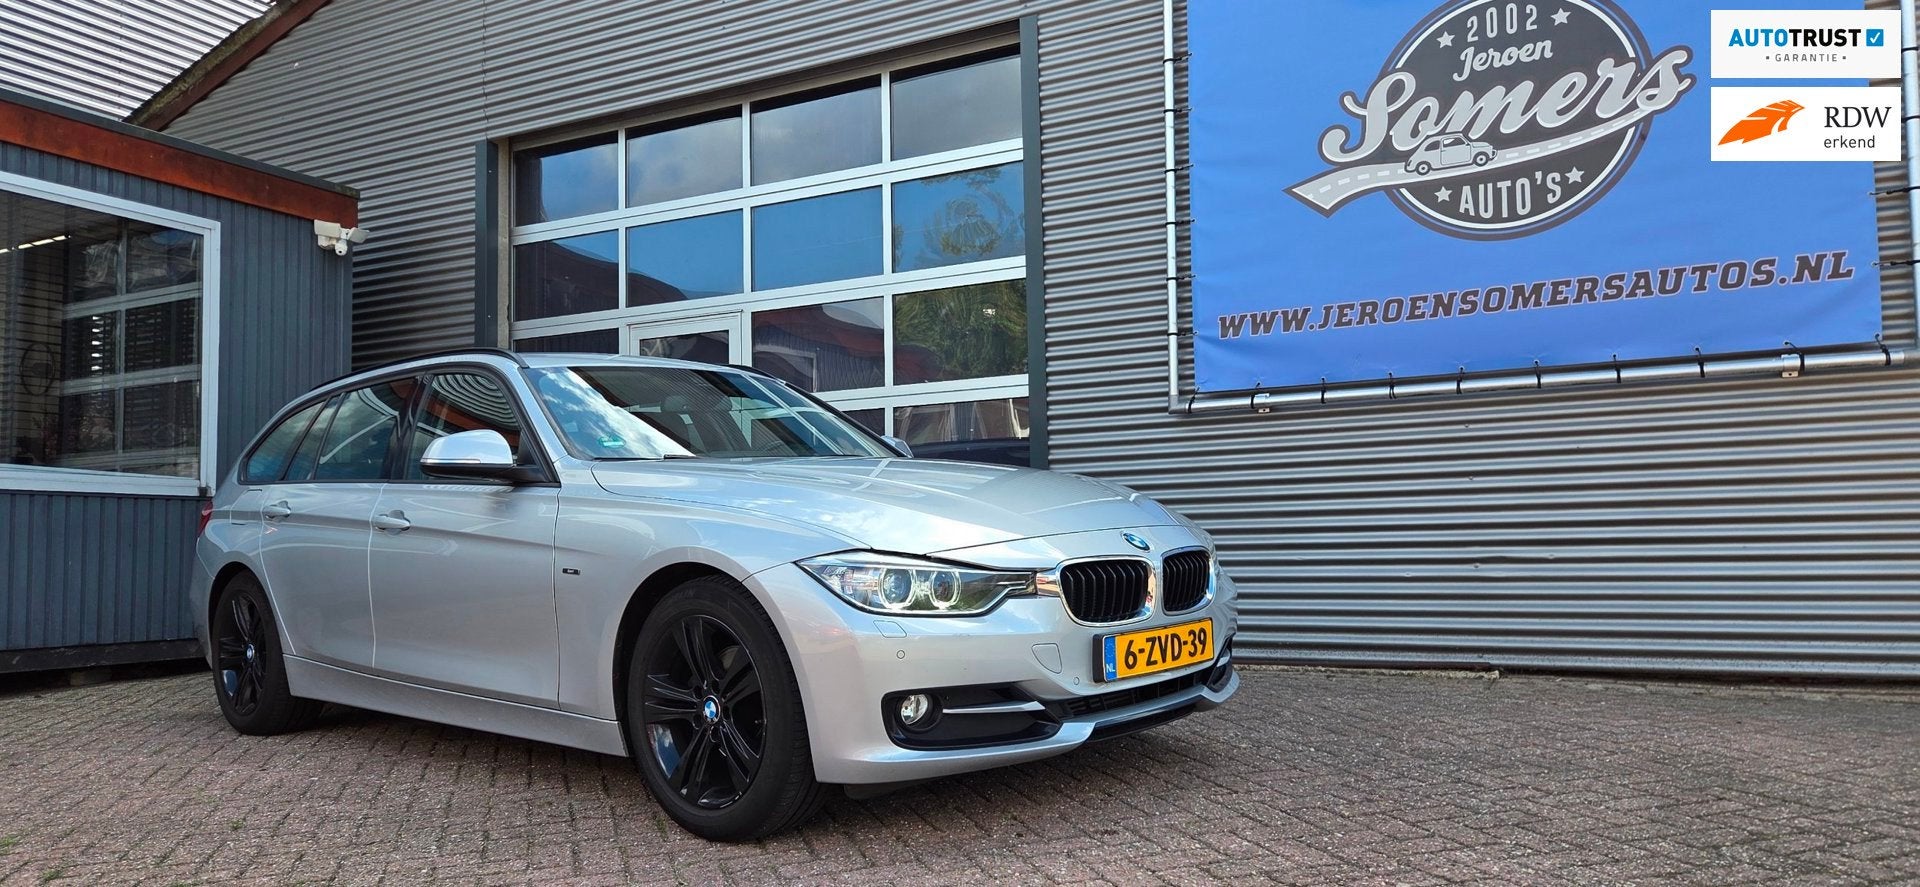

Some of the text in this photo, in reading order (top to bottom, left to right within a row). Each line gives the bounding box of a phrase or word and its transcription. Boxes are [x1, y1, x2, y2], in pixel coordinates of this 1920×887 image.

[1467, 3, 1537, 42] 2002
[1453, 40, 1553, 81] Jeroen
[1321, 50, 1692, 163] Somers
[1459, 171, 1562, 218] AUTO'S
[1218, 250, 1854, 339] WWW.JEROENSOMERSAUTOS.NL
[1106, 664, 1115, 673] NL
[1124, 627, 1207, 670] 6-ZVD-39
